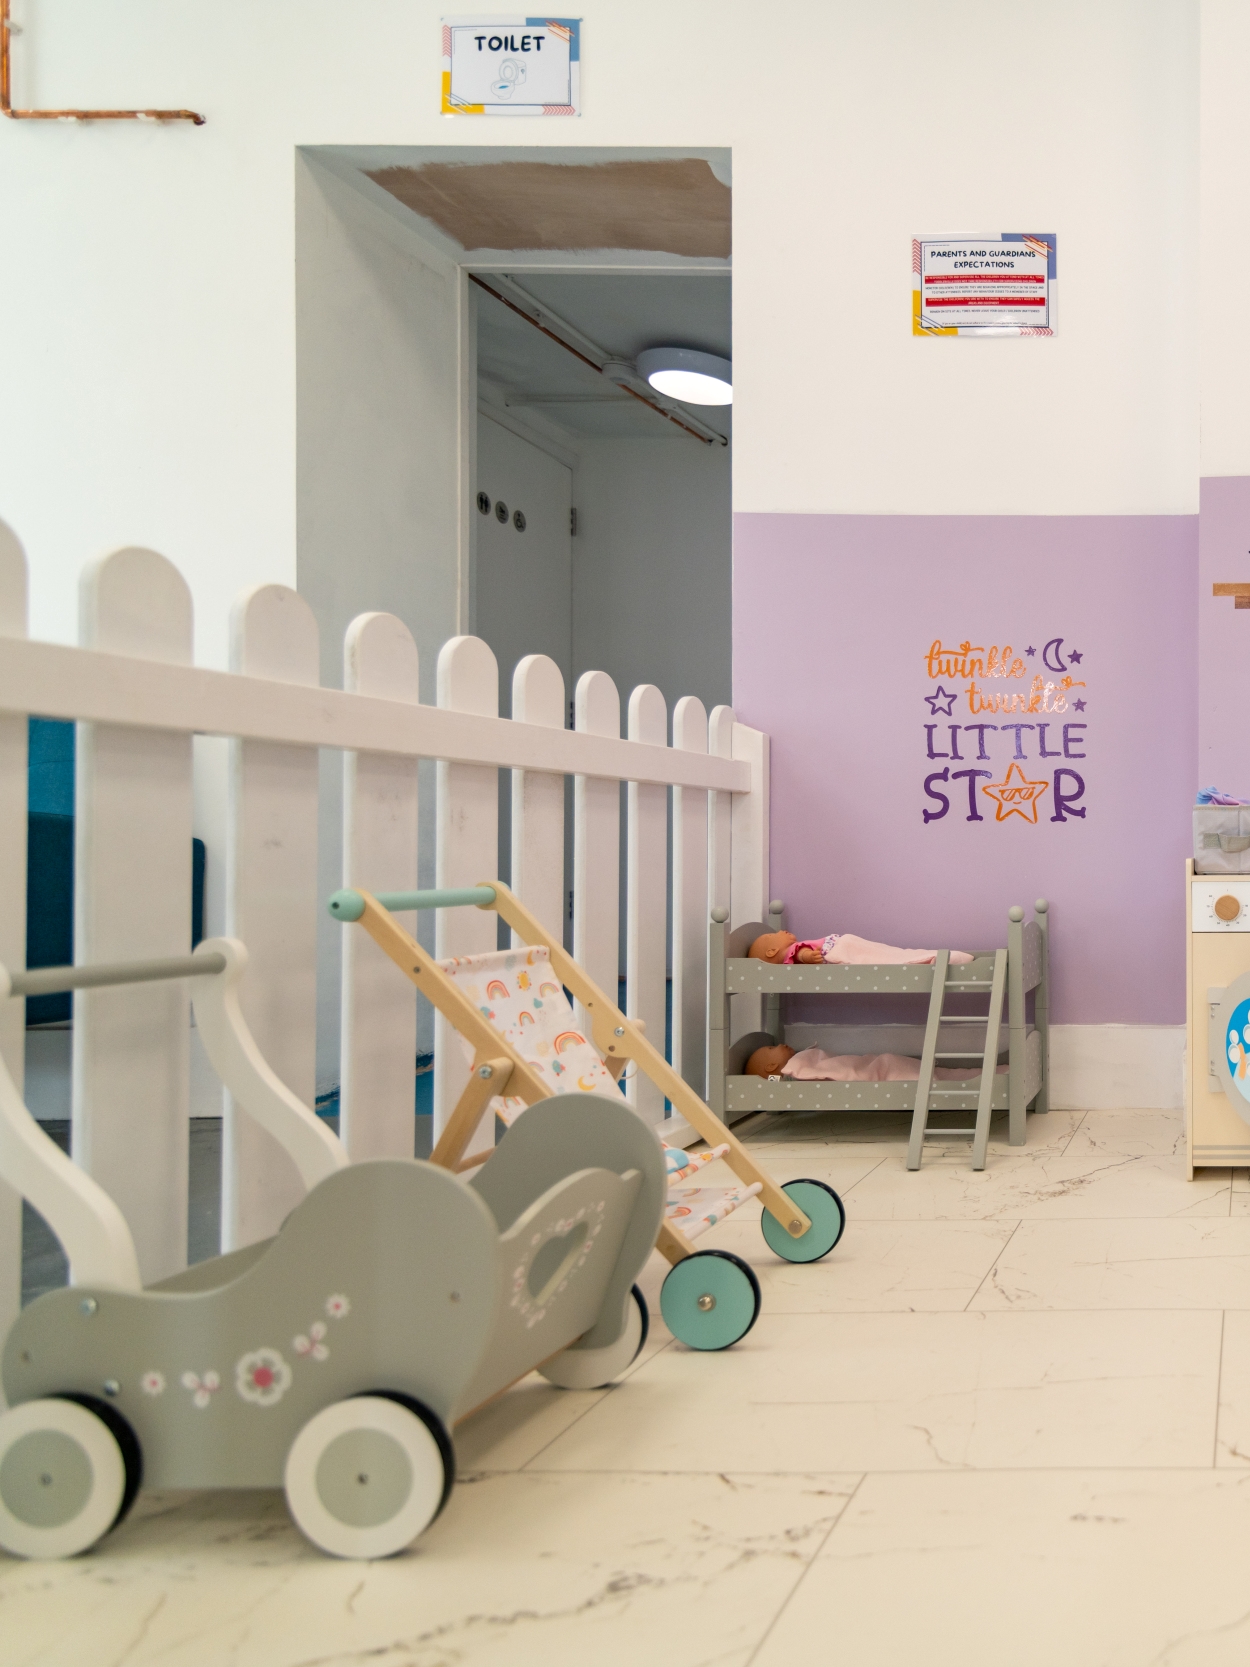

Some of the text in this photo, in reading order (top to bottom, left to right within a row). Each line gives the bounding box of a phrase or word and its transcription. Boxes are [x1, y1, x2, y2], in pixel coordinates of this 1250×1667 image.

[474, 35, 545, 52] TOILET
[930, 250, 1036, 258] PARENTS AND GUARDIANS
[953, 261, 1015, 269] EXPECTATIONS
[923, 639, 1027, 679] twinkle
[964, 674, 1086, 715] twinkle
[923, 723, 1088, 761] LITTLE
[922, 763, 1087, 824] STR
